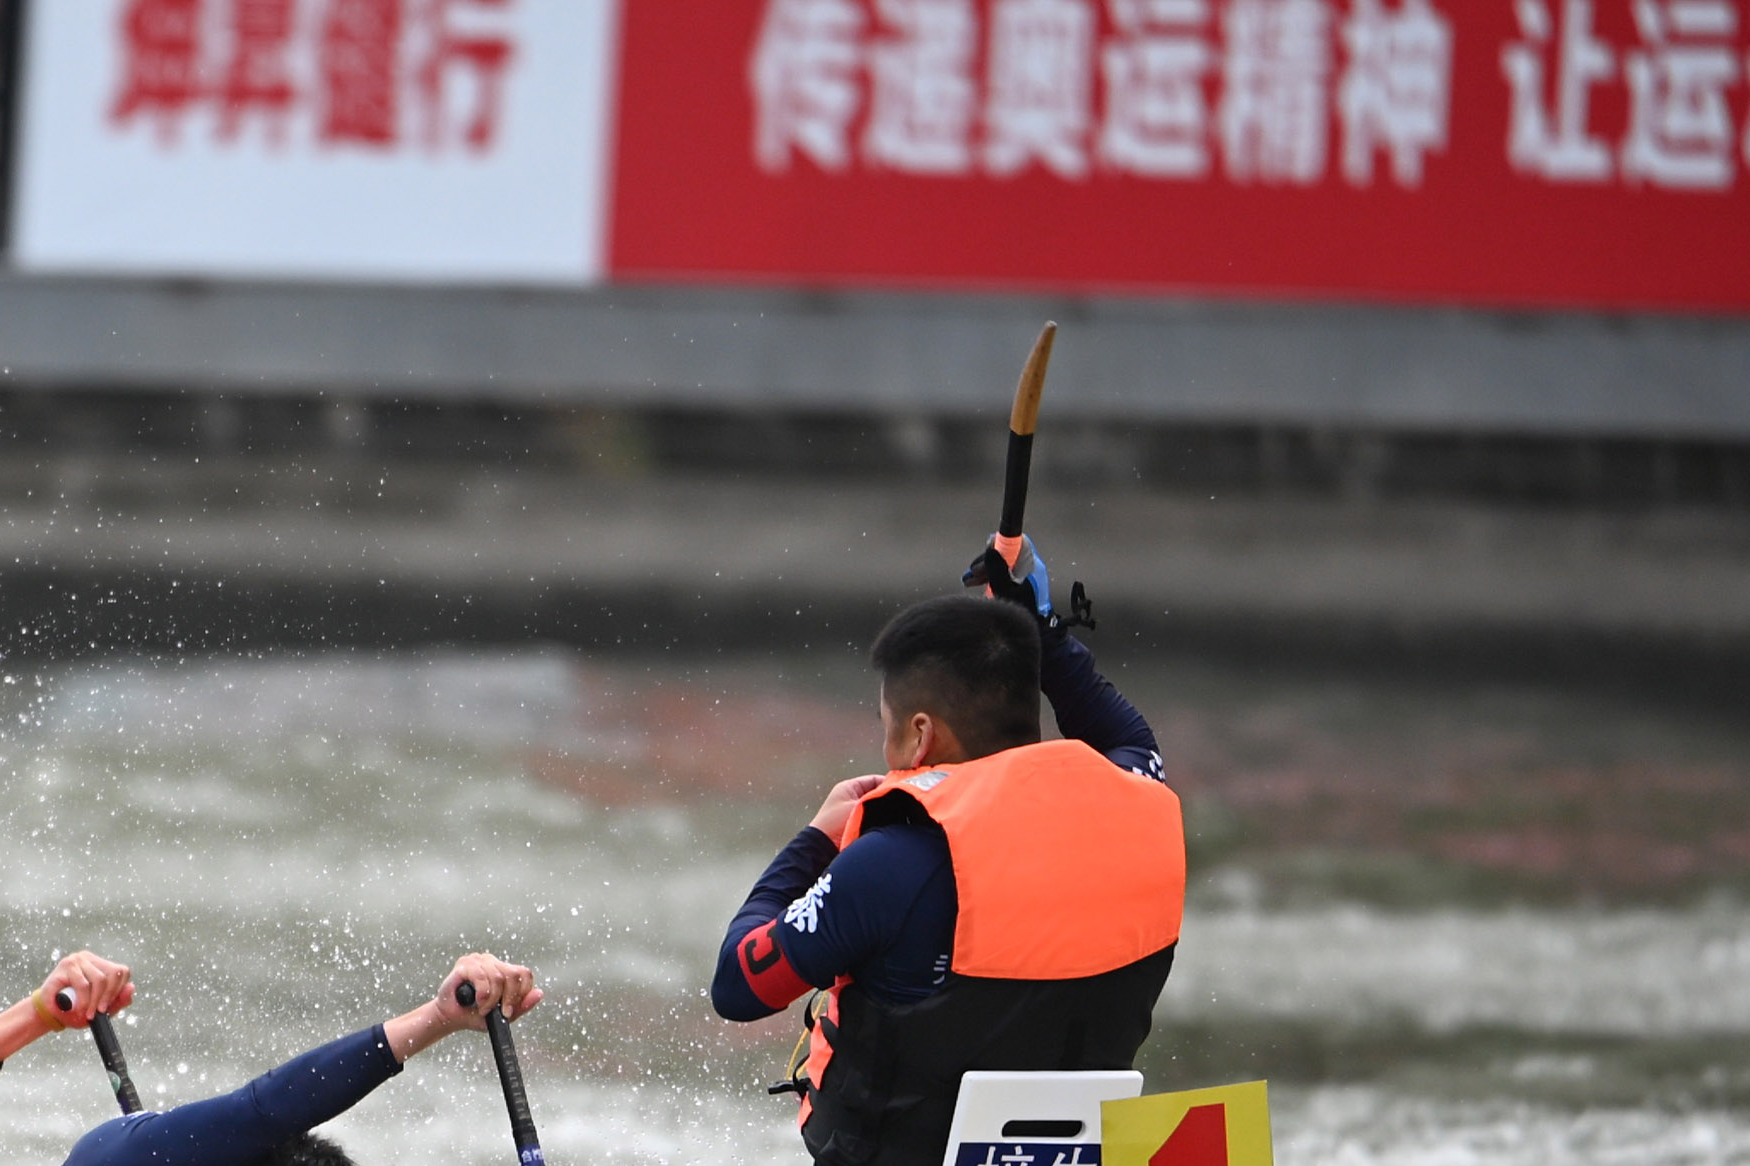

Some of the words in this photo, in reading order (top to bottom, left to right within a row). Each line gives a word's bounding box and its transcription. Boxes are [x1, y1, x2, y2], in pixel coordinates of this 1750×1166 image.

[749, 0, 1452, 187] 传递奥运精神
[1502, 0, 1750, 190] 让运
